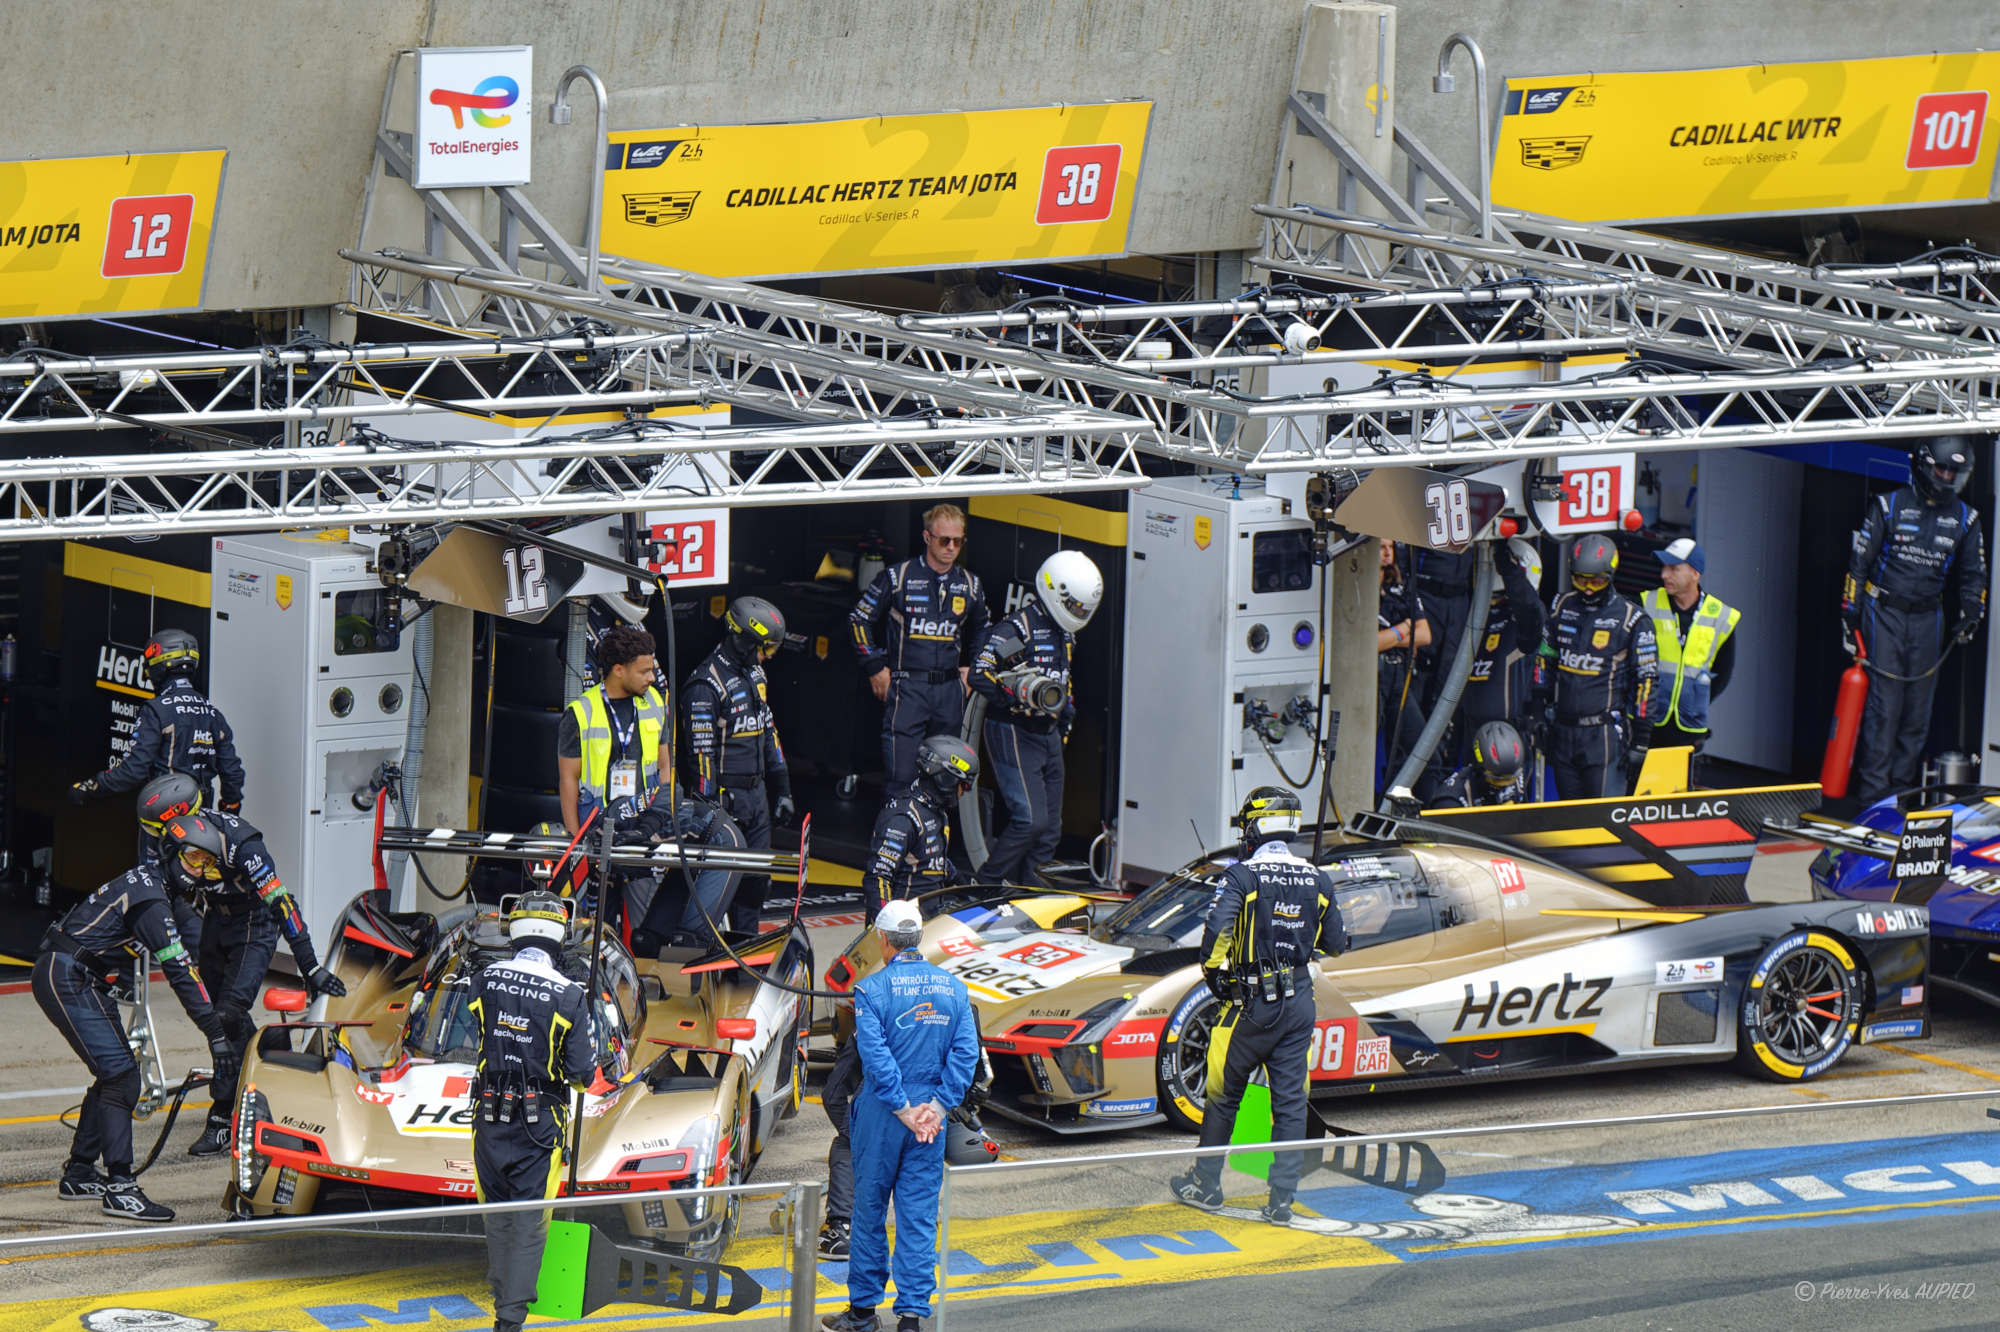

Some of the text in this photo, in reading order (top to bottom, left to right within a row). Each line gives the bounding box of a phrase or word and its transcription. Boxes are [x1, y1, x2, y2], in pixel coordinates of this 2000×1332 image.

[1670, 116, 1842, 147] CADILLAC WTR
[1923, 109, 1976, 151] 101
[428, 138, 519, 156] TotalEnergies
[631, 145, 667, 158] WEC
[1703, 151, 1745, 167] Cadillac
[725, 171, 1017, 208] CADILLAC HERTZ TEAM JOTA
[1056, 162, 1102, 207] 38
[818, 211, 864, 226] Cadillac
[27, 223, 80, 249] JOTA
[124, 213, 172, 259] 12
[1568, 470, 1612, 520] 38
[1425, 478, 1473, 551] 38
[503, 544, 549, 616] 12
[909, 617, 957, 636] Hertz
[110, 720, 137, 734] JOT
[1611, 800, 1729, 823] CADILLAC
[1912, 834, 1947, 848] Palantir
[1248, 862, 1320, 876] CADILLAC
[1493, 861, 1520, 889] HY
[1896, 860, 1940, 878] BRADY
[1260, 874, 1315, 886] RACING
[1856, 910, 1906, 933] Mobil
[1764, 935, 1804, 969] MICHELIN
[483, 969, 566, 994] CADILLAC
[891, 974, 951, 985] CONTRÔLE PISTE
[948, 958, 1049, 995] Hertz
[486, 981, 551, 1002] RACING
[891, 985, 955, 997] PIT LANE CONTROL
[1453, 972, 1615, 1032] Hertz
[497, 1010, 531, 1028] Hertz
[493, 1028, 533, 1044] Racing Gold
[1111, 1031, 1156, 1045] JOTA
[1358, 1040, 1387, 1053] HYPER
[1356, 1052, 1388, 1072] CAR
[356, 1085, 393, 1104] HY
[1103, 1102, 1151, 1113] MICHELIN
[281, 1116, 314, 1133] Mobil
[622, 1140, 658, 1153] Mobil
[438, 1181, 476, 1193] JOT
[1601, 1160, 2000, 1215] MIC
